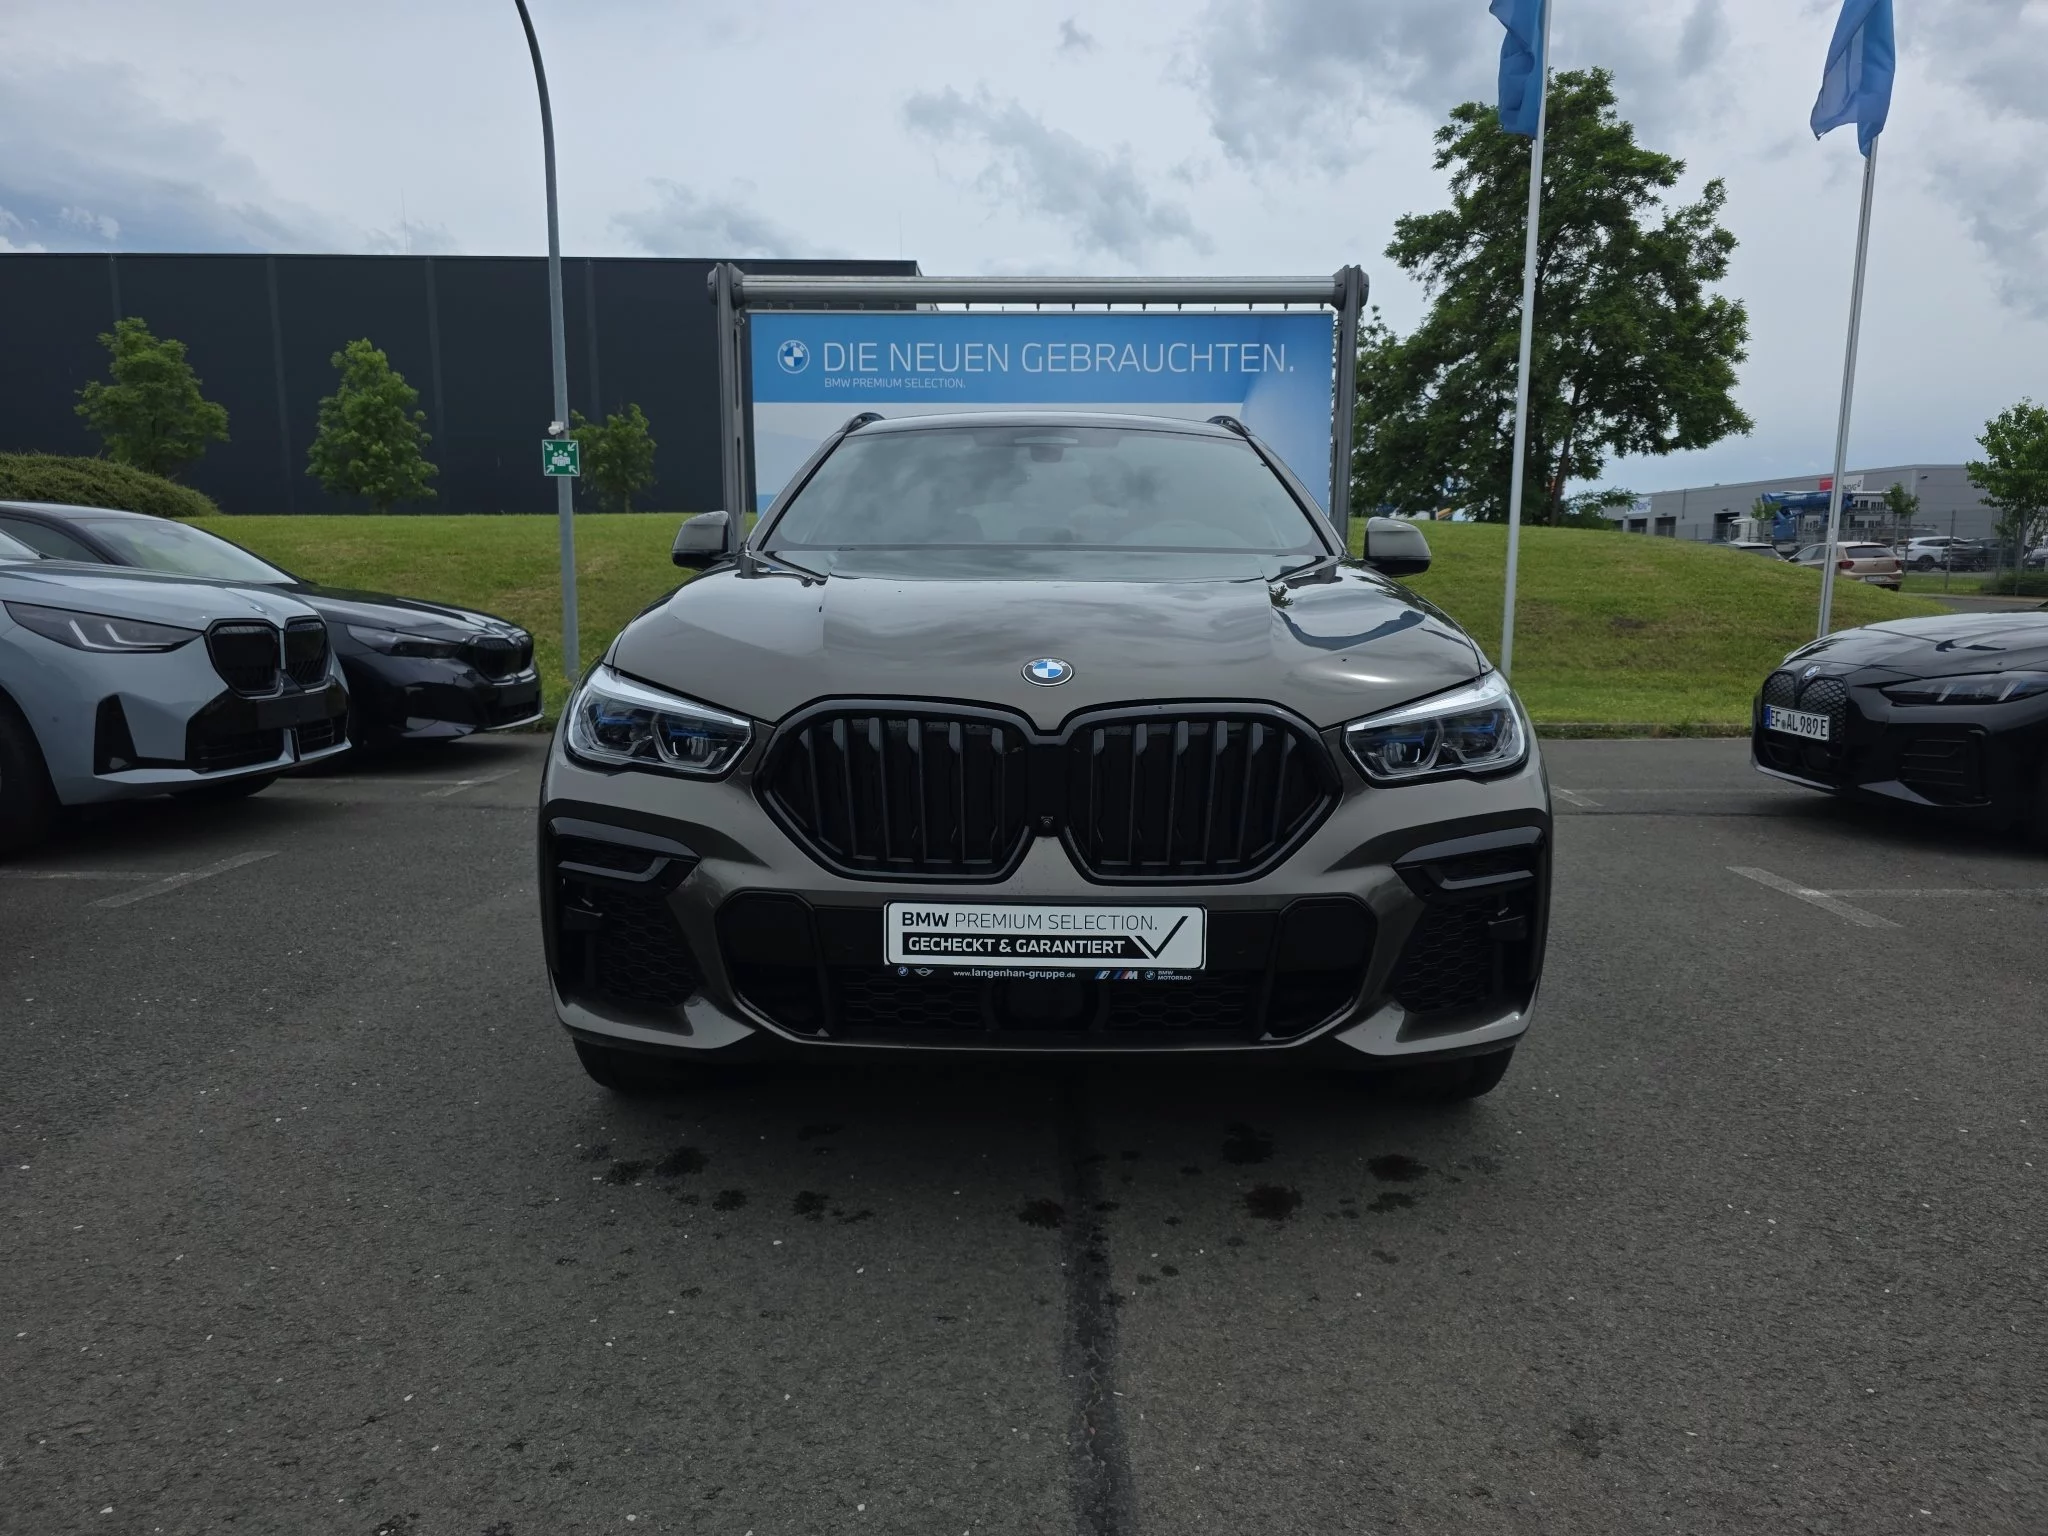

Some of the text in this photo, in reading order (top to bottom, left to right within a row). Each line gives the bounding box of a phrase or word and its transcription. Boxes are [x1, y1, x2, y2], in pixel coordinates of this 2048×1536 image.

[823, 342, 1295, 373] DIE NEUEN GEBRAUCHTEN.
[824, 378, 966, 389] BMW PREMIUM SELECTION.
[1770, 709, 1781, 728] EF
[1787, 713, 1798, 732] AL
[902, 911, 1158, 931] BMW PREMIUM SELECTION.
[908, 936, 1125, 954] GECHECKT & GARANTIERT
[953, 968, 1076, 980] www.langenhan-gruppe.de
